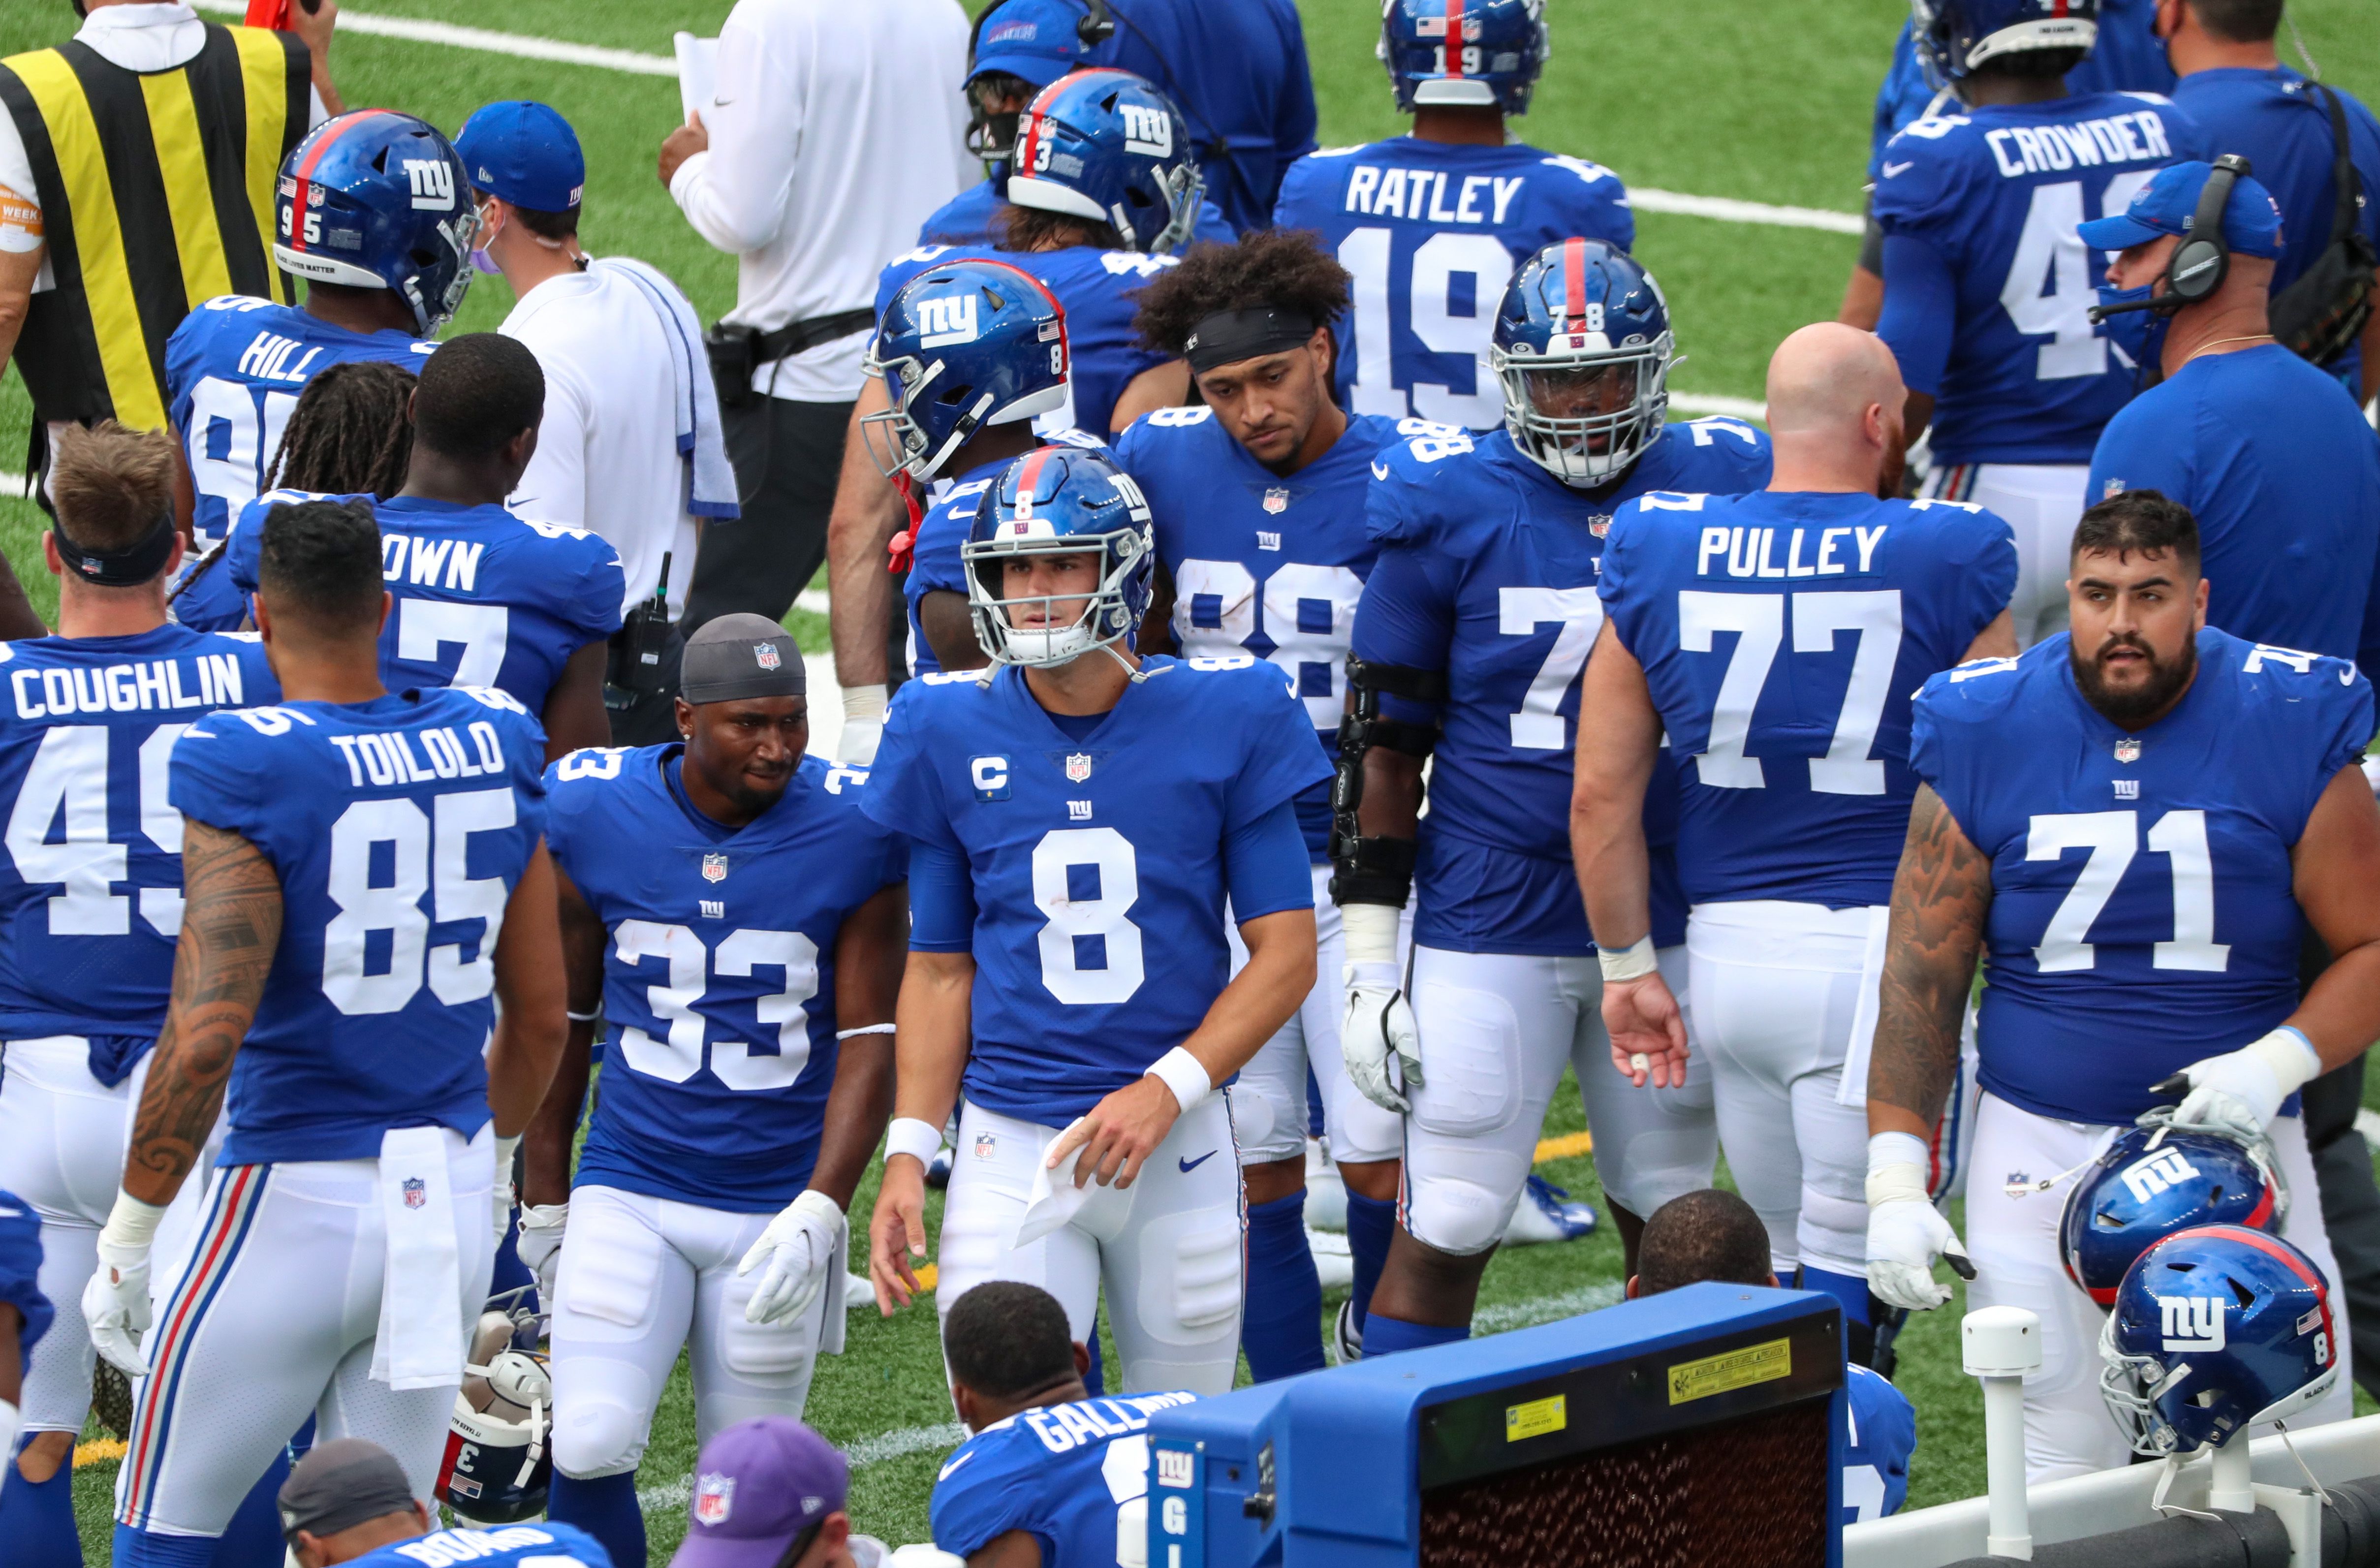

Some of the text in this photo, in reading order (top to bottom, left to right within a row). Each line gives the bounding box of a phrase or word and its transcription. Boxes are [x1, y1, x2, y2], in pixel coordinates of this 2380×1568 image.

[1985, 110, 2172, 178] CROWDER
[1346, 166, 1525, 224] RATLEY
[2, 205, 38, 220] WEEK
[306, 264, 335, 274] MATTER
[1338, 227, 1514, 430] 19
[1549, 303, 1605, 334] 78
[238, 330, 324, 382] HILL
[1014, 491, 1034, 520] 8
[1266, 498, 1284, 510] NFL
[1697, 525, 1888, 578] PULLEY
[759, 653, 779, 667] NFL
[11, 653, 244, 720] COUGHLIN
[1678, 590, 1902, 795] 77
[329, 721, 505, 786] TOILOLO
[2117, 749, 2137, 758] NFL
[971, 757, 1008, 790] C
[1070, 764, 1087, 776] NFL
[706, 865, 724, 877] NFL
[322, 787, 517, 1015] 85
[2025, 810, 2231, 973] 71
[1032, 827, 1145, 1005] 8
[613, 918, 819, 1091] 33
[976, 1143, 993, 1155] NFL
[405, 1191, 423, 1204] NFL
[2314, 1331, 2328, 1366] 8
[2304, 1384, 2325, 1400] BLACK
[451, 1416, 460, 1426] ALL
[459, 1422, 475, 1435] TAKES
